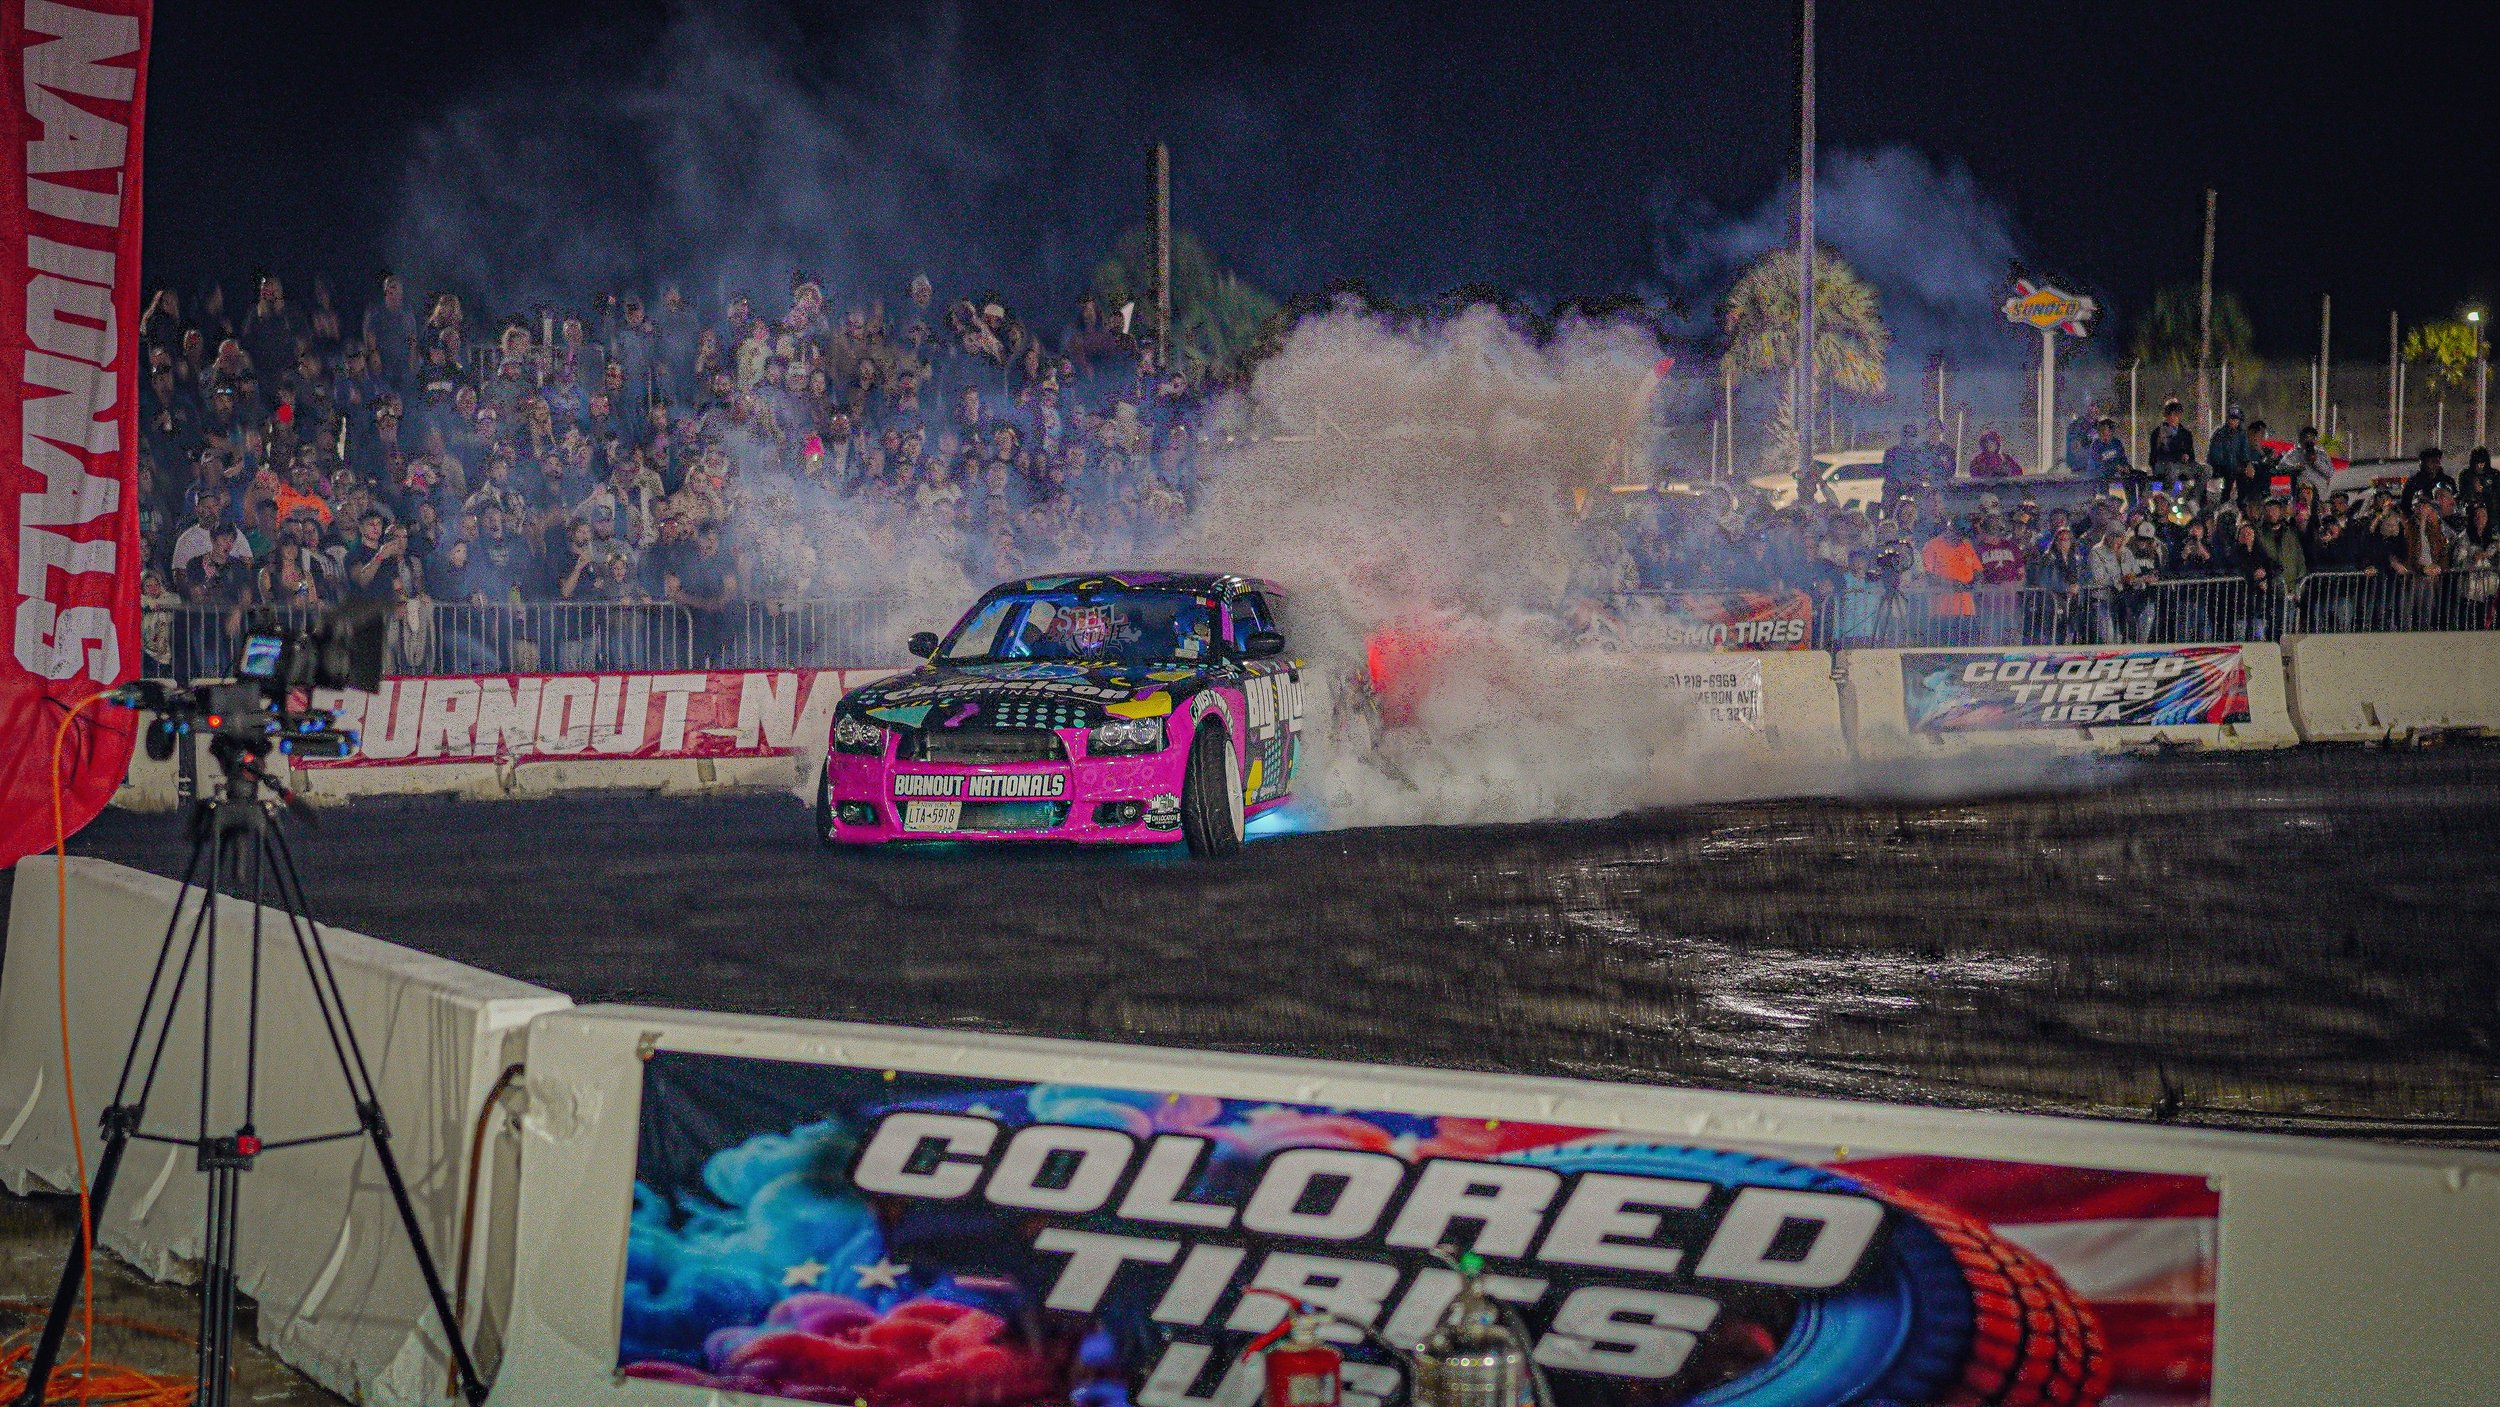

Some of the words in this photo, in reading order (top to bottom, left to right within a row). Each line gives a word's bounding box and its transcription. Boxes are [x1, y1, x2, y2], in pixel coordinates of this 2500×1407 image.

[14, 0, 140, 685] NATIONALS
[1736, 618, 1805, 644] TIRES
[1683, 674, 1737, 688] 218-6969
[1962, 657, 2186, 683] COLORED
[937, 690, 1056, 698] COATINGS
[2010, 680, 2158, 705] TIRES
[304, 673, 708, 760] BURNOUT
[2041, 702, 2121, 722] USA
[895, 774, 964, 796] BURNOUT
[969, 774, 1065, 796] NATIONALS
[854, 1112, 1886, 1288] COLORED
